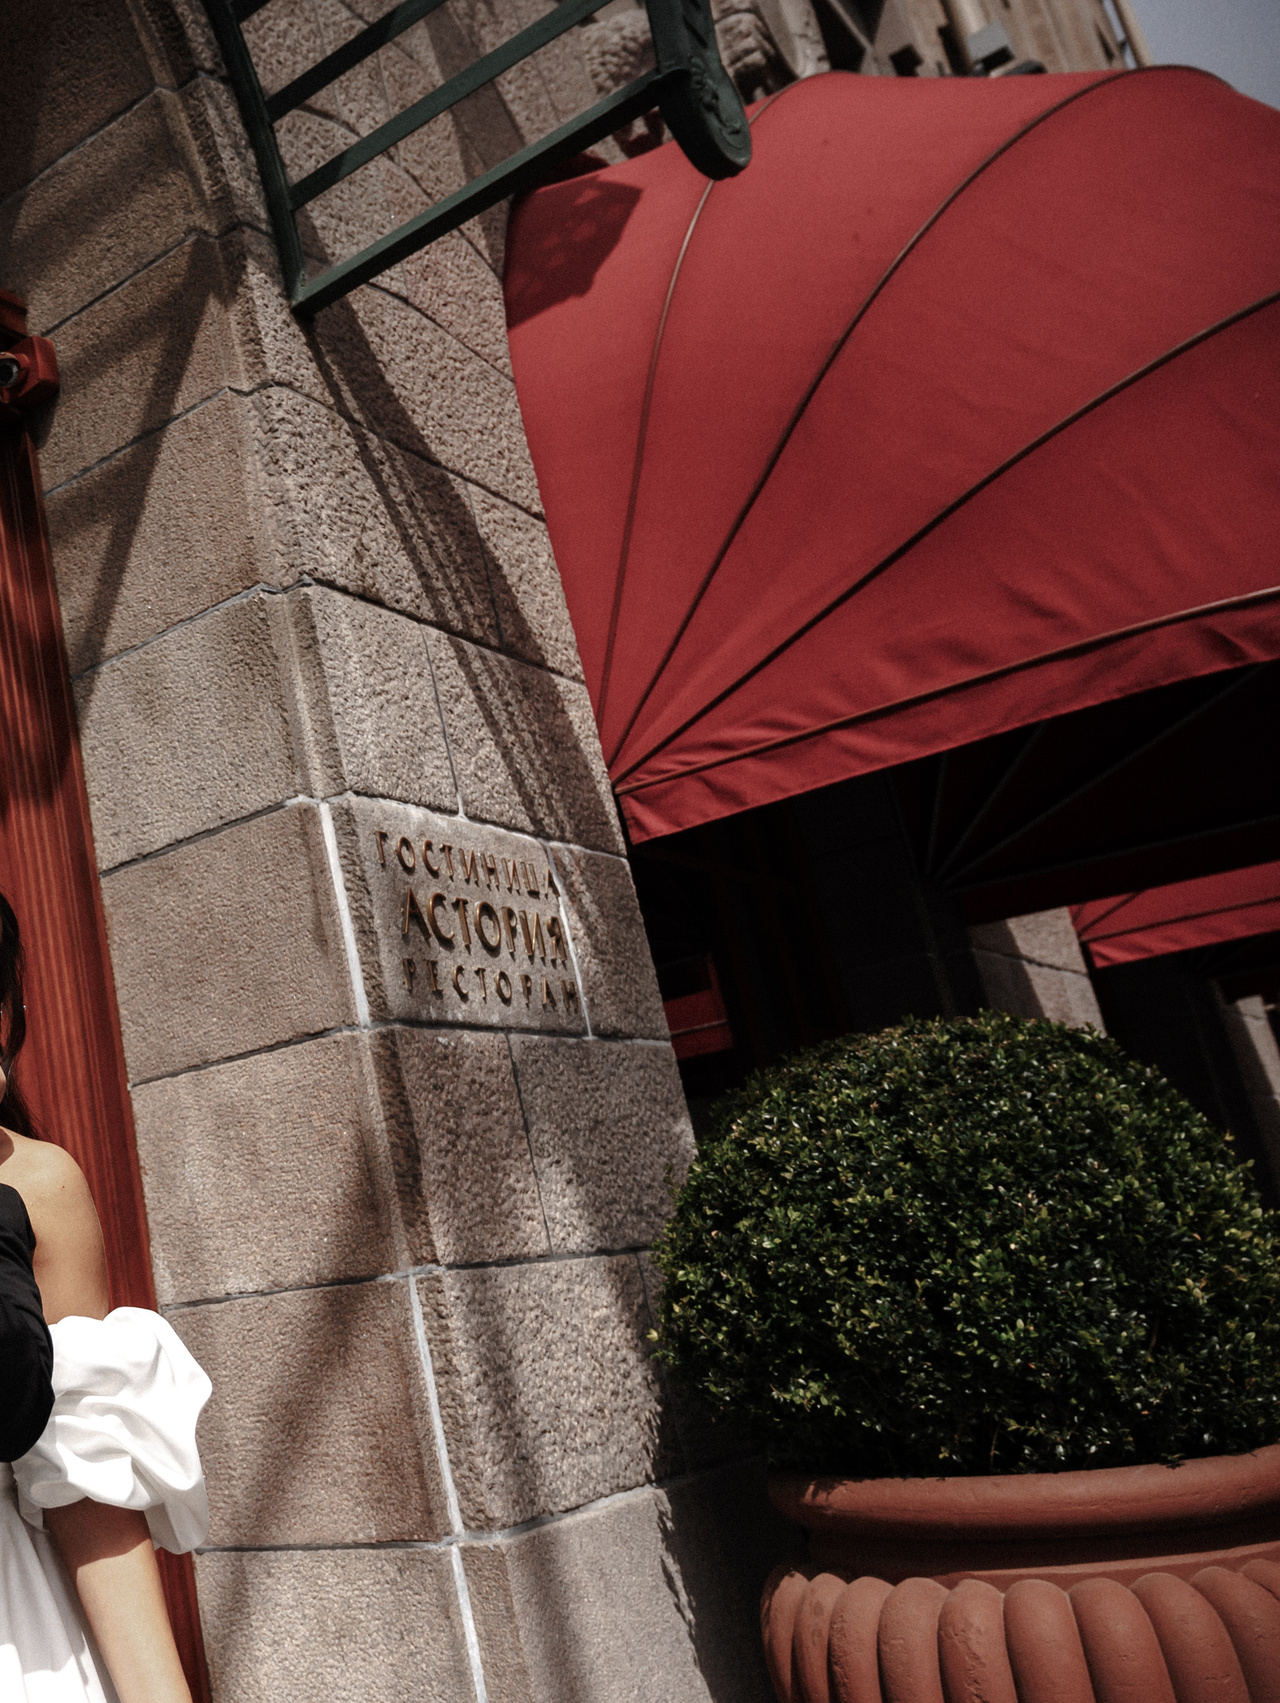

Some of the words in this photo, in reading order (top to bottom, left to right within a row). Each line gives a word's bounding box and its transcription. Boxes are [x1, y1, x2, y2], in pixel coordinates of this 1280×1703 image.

[374, 830, 561, 898] ГОСТИНИЦА
[402, 886, 568, 963] АСТОРИЯ
[401, 957, 579, 1014] РЕСТОРАН
